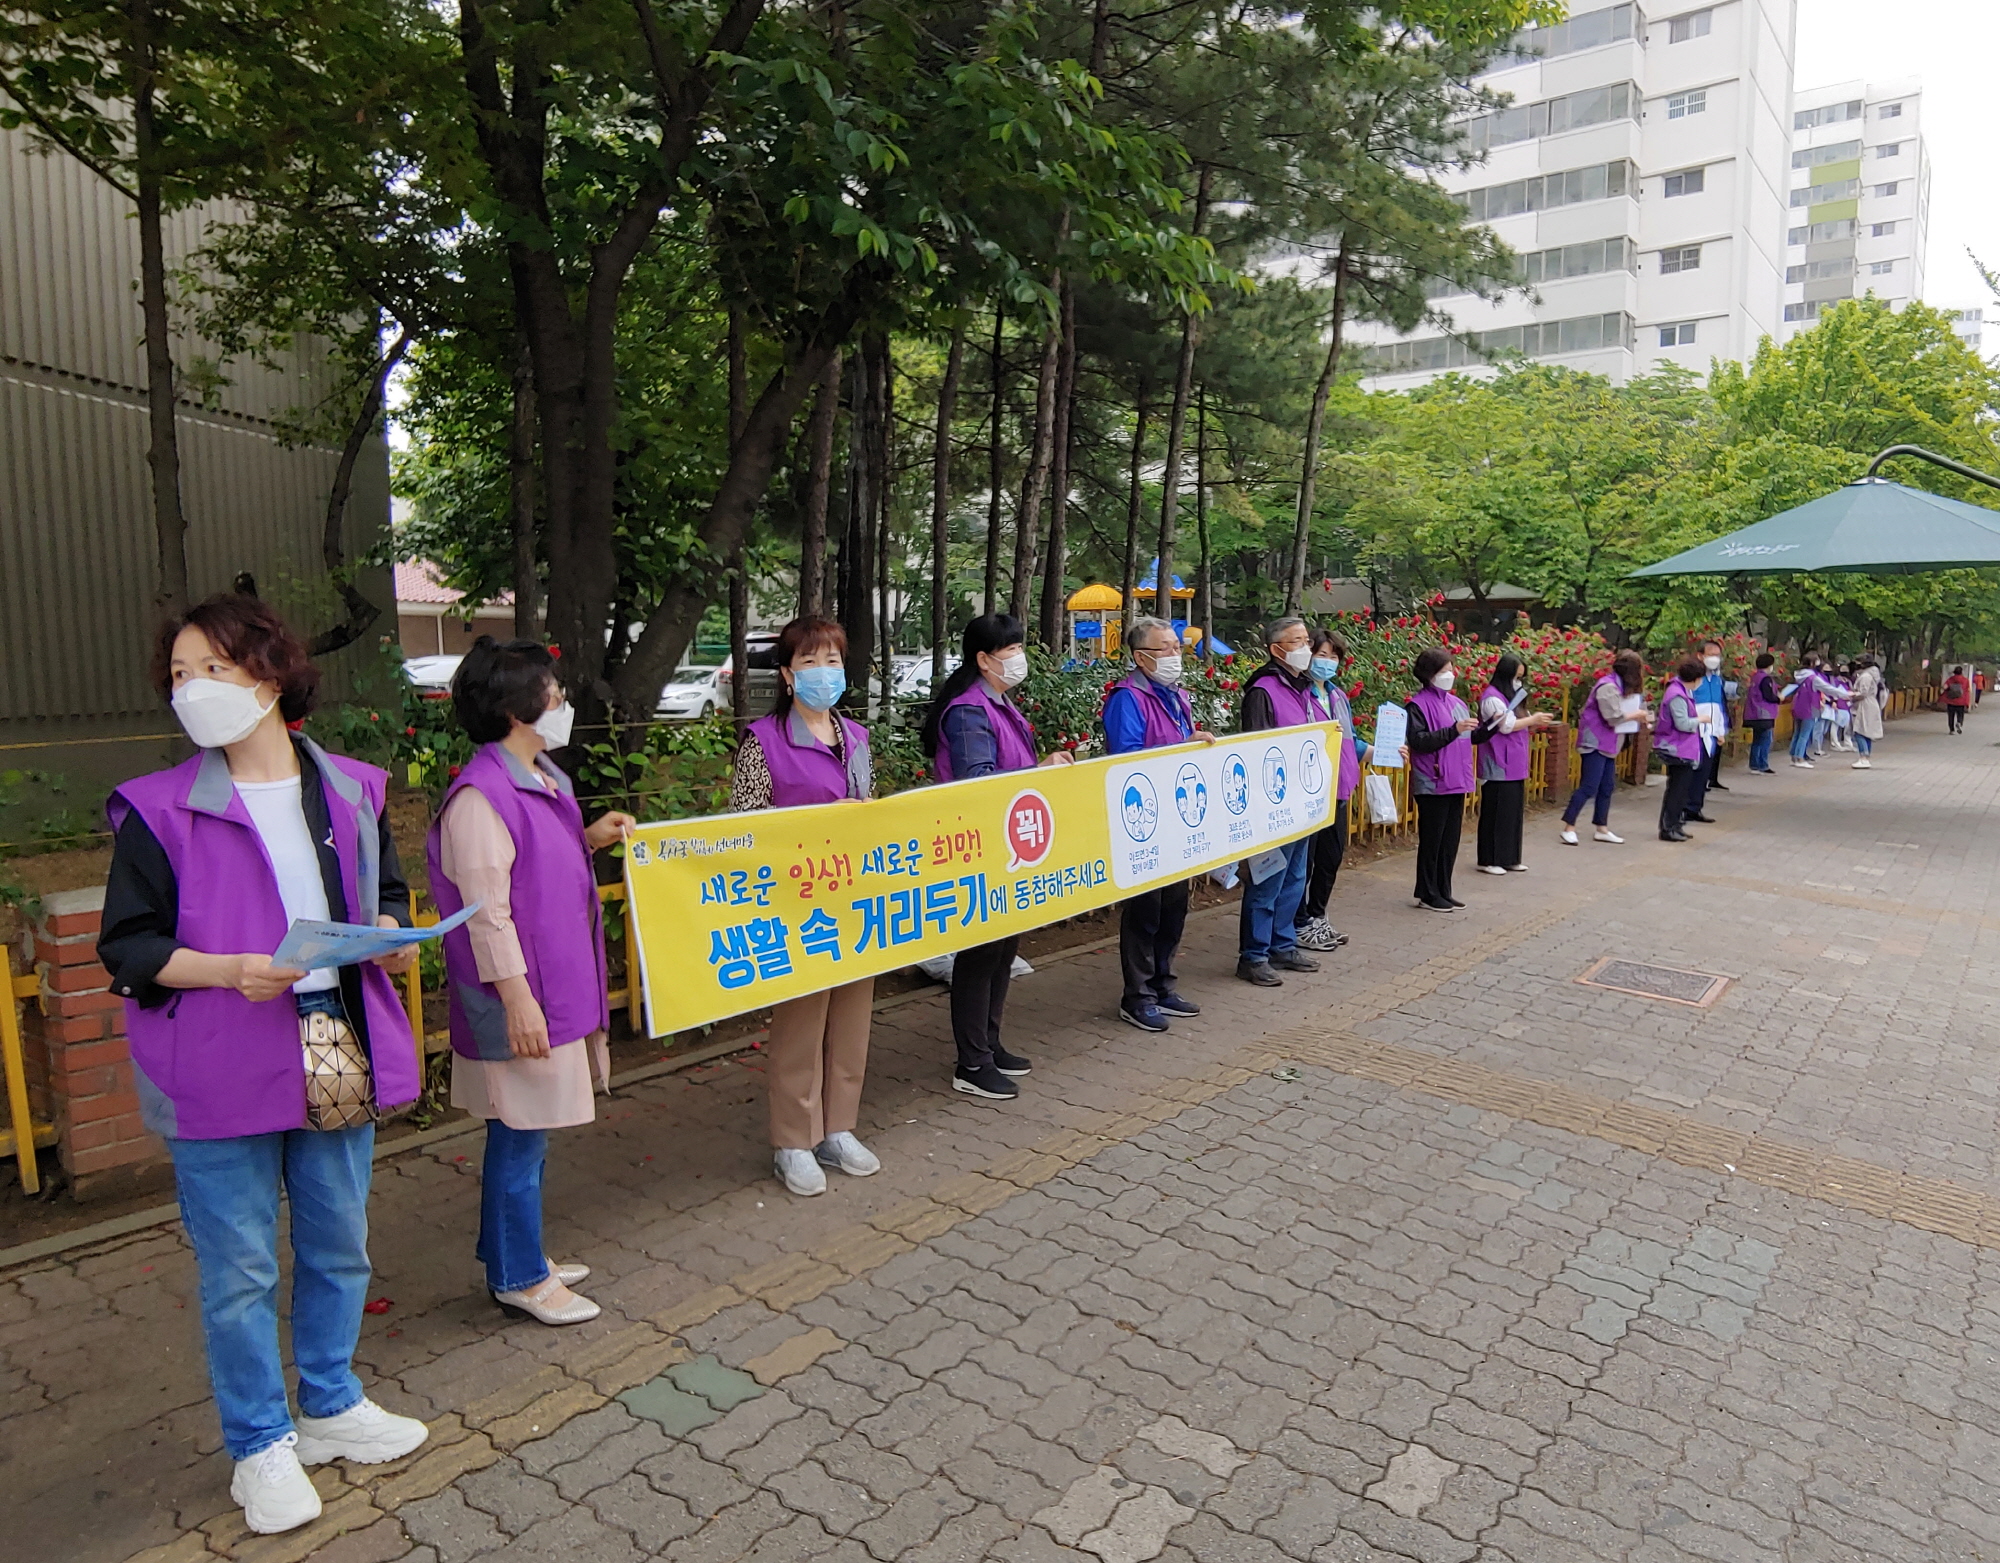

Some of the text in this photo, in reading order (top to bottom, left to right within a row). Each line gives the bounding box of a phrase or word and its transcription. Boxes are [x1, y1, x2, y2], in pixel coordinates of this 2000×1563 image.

[701, 828, 982, 906] 새로운 일상! 새로운 희망!
[1016, 809, 1045, 848] 꼭!
[708, 859, 1108, 989] 생활 속 거리두기에 동참해주세요
